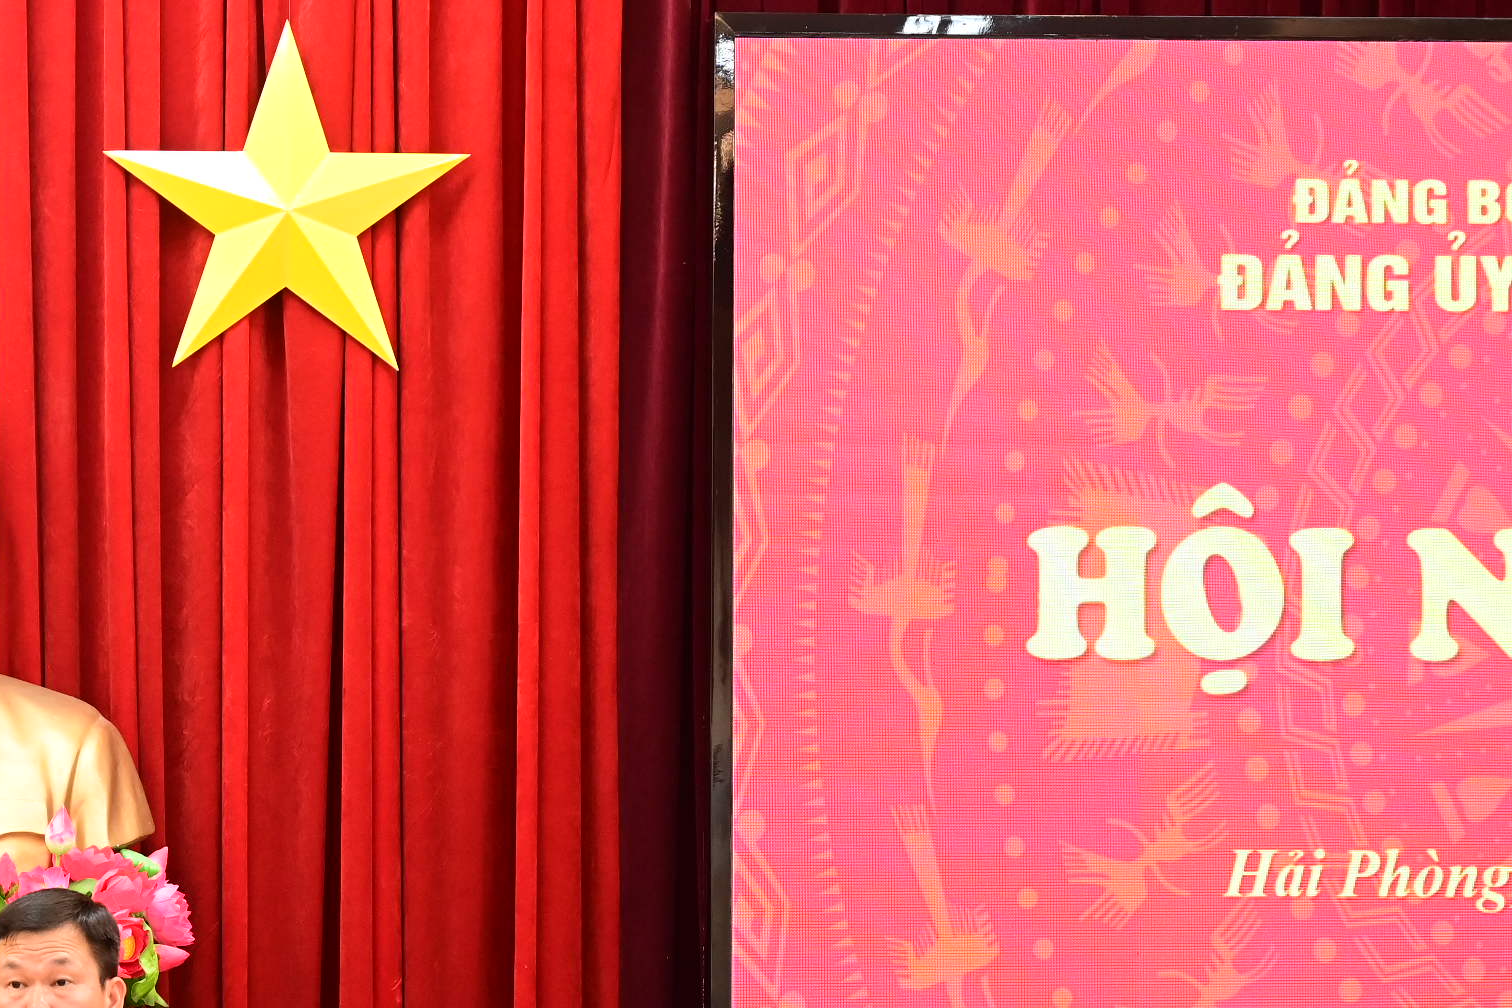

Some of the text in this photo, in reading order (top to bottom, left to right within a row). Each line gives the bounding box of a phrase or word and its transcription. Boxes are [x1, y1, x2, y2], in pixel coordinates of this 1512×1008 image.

[1293, 159, 1512, 225] ĐẢNG B
[1217, 229, 1512, 313] ĐẢNG ỦY
[1025, 482, 1356, 696] HỘI
[1223, 848, 1327, 898] Hải
